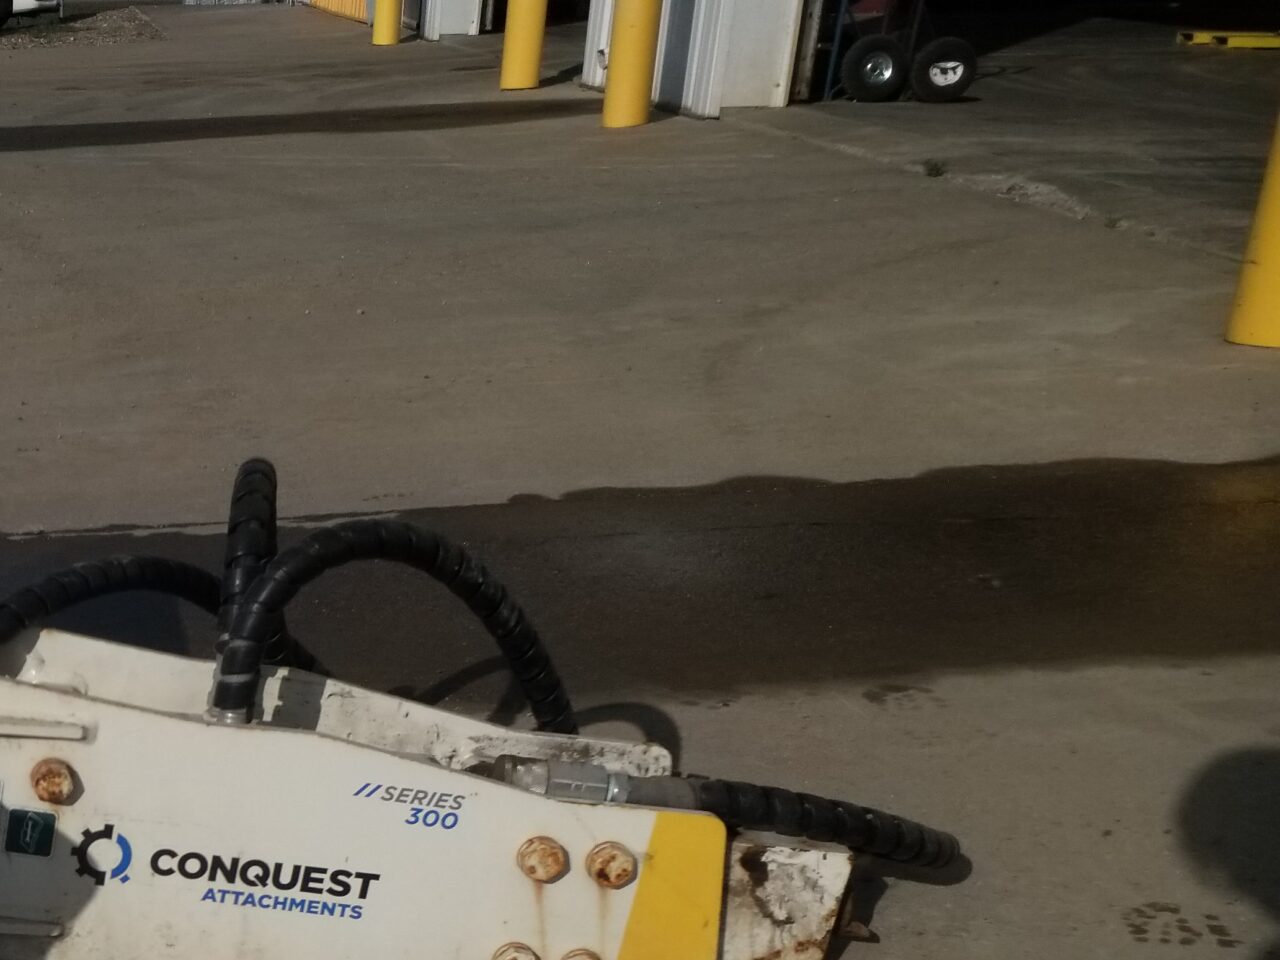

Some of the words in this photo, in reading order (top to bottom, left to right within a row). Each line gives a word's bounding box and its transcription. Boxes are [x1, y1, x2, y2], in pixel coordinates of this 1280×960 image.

[404, 807, 459, 830] 300
[150, 848, 381, 899] CONQUEST
[201, 887, 363, 920] ATTACHMENTS
